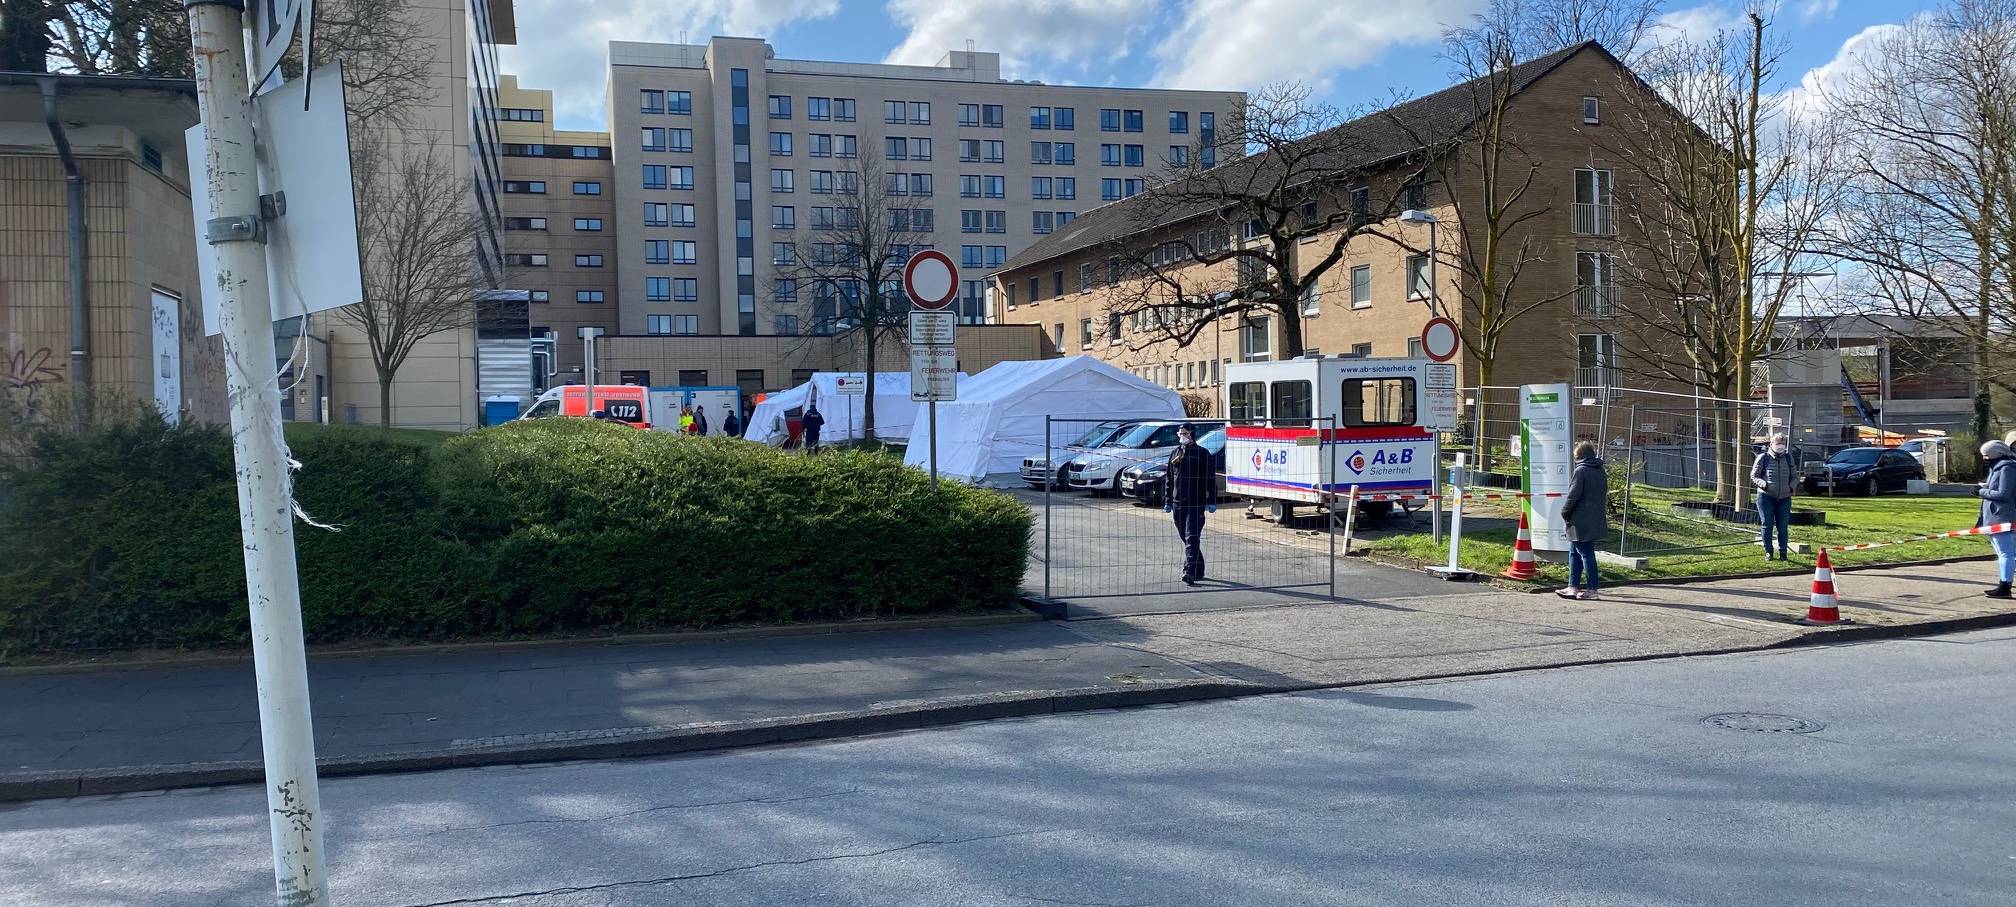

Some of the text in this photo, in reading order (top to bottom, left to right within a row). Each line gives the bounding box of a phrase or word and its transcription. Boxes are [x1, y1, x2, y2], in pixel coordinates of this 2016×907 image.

[1340, 365, 1417, 373] www.ab-sicherheit.de
[618, 405, 637, 418] 112
[1370, 466, 1411, 476] Sicherheit
